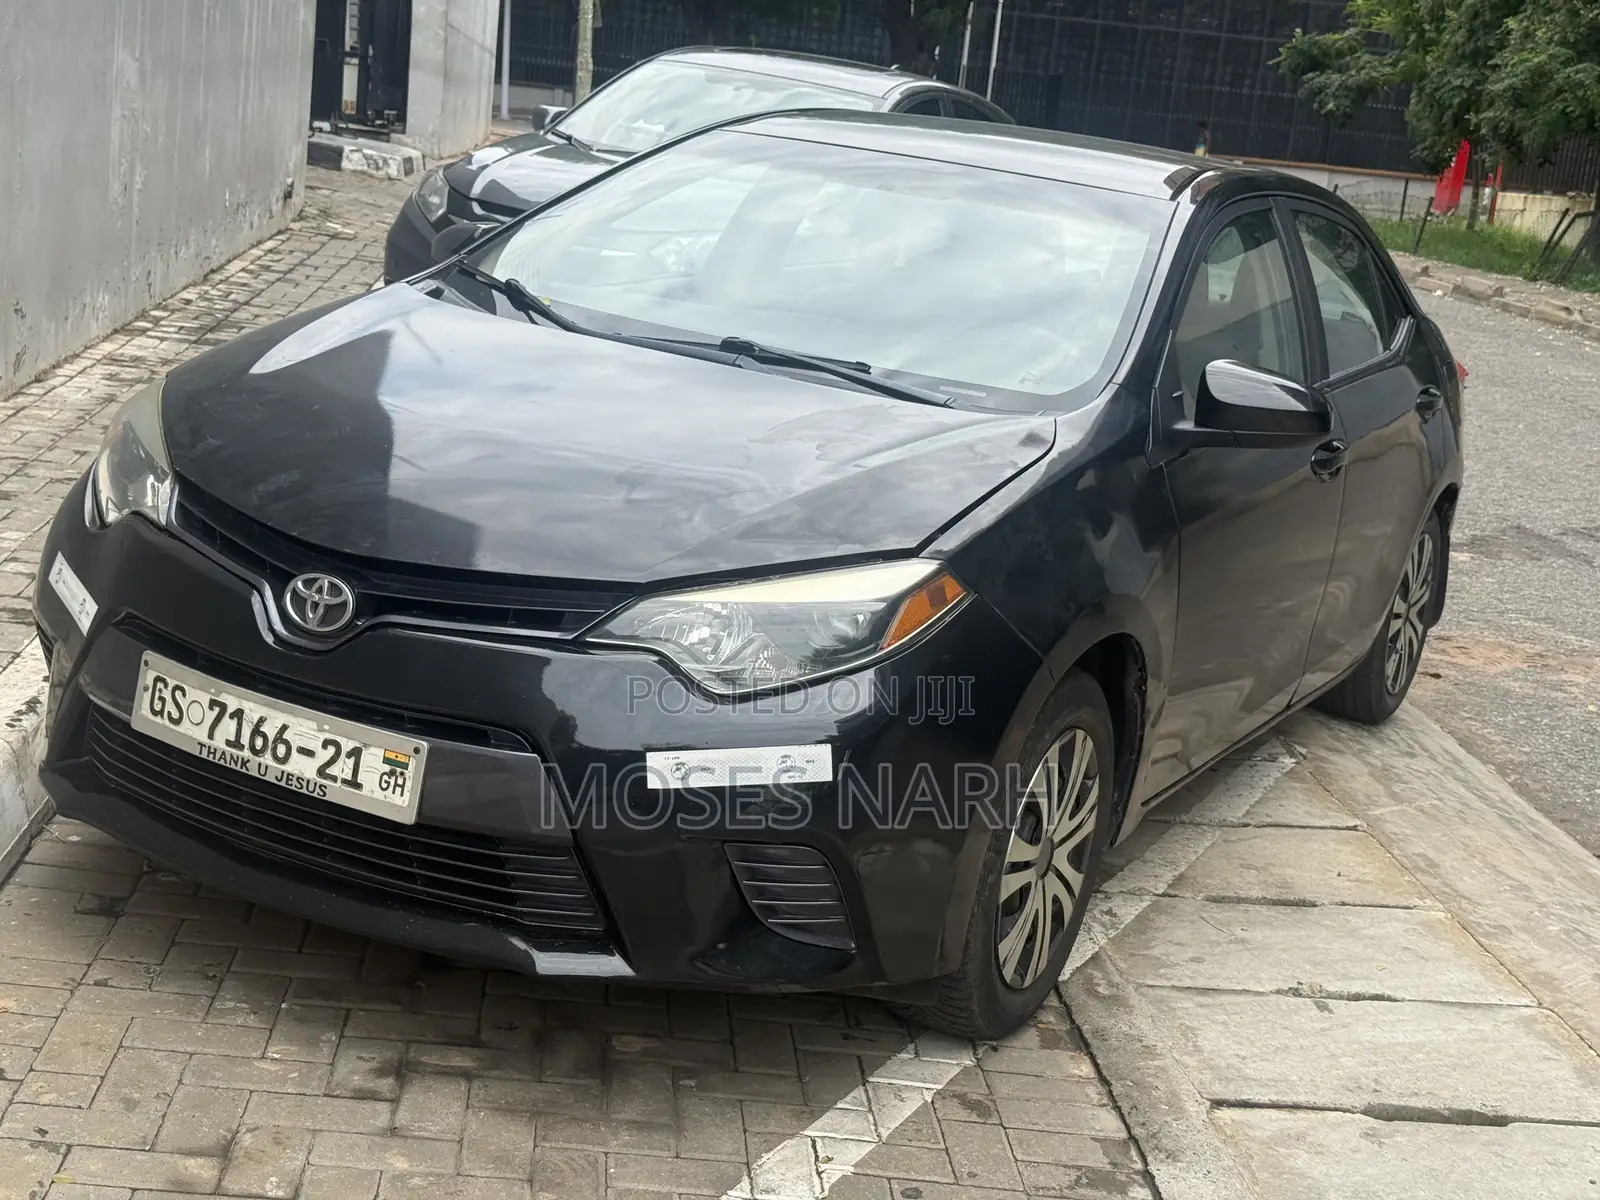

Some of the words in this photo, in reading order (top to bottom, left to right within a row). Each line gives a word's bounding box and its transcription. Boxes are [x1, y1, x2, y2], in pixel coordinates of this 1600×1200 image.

[149, 675, 187, 726] GS
[207, 697, 364, 790] 7166-21
[197, 741, 251, 773] THANK
[256, 761, 269, 778] U
[274, 769, 328, 798] JESUS
[378, 770, 407, 798] GH
